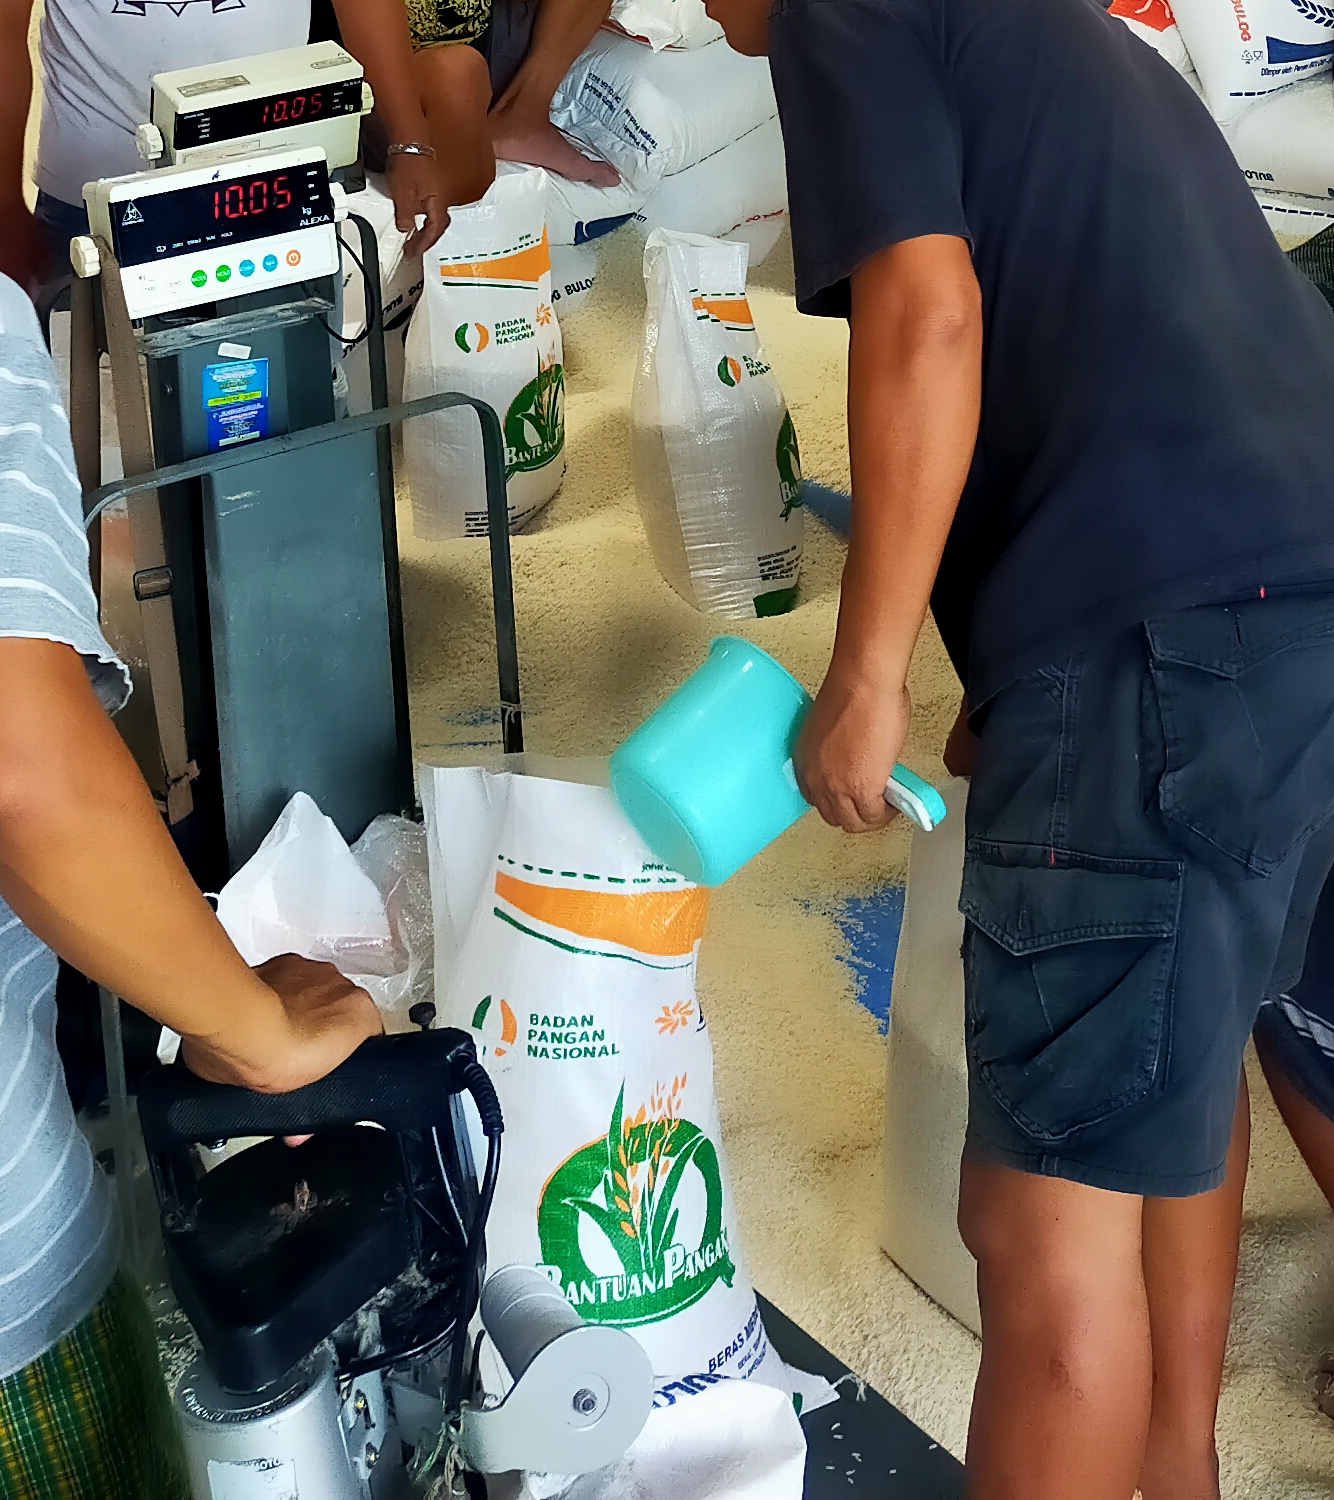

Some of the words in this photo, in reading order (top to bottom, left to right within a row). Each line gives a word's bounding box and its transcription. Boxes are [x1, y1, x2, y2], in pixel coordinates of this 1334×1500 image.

[214, 175, 292, 219] 10.05
[299, 214, 331, 227] ALEXA
[494, 316, 527, 330] BADAN
[495, 323, 532, 338] PANGAN
[529, 1012, 595, 1028] BADAN
[527, 1028, 605, 1045] PANGAN
[526, 1043, 621, 1060] NASIONAL
[535, 1263, 655, 1306] BANTUAN
[663, 1227, 731, 1289] PANGAN
[708, 1332, 745, 1375] BERAS
